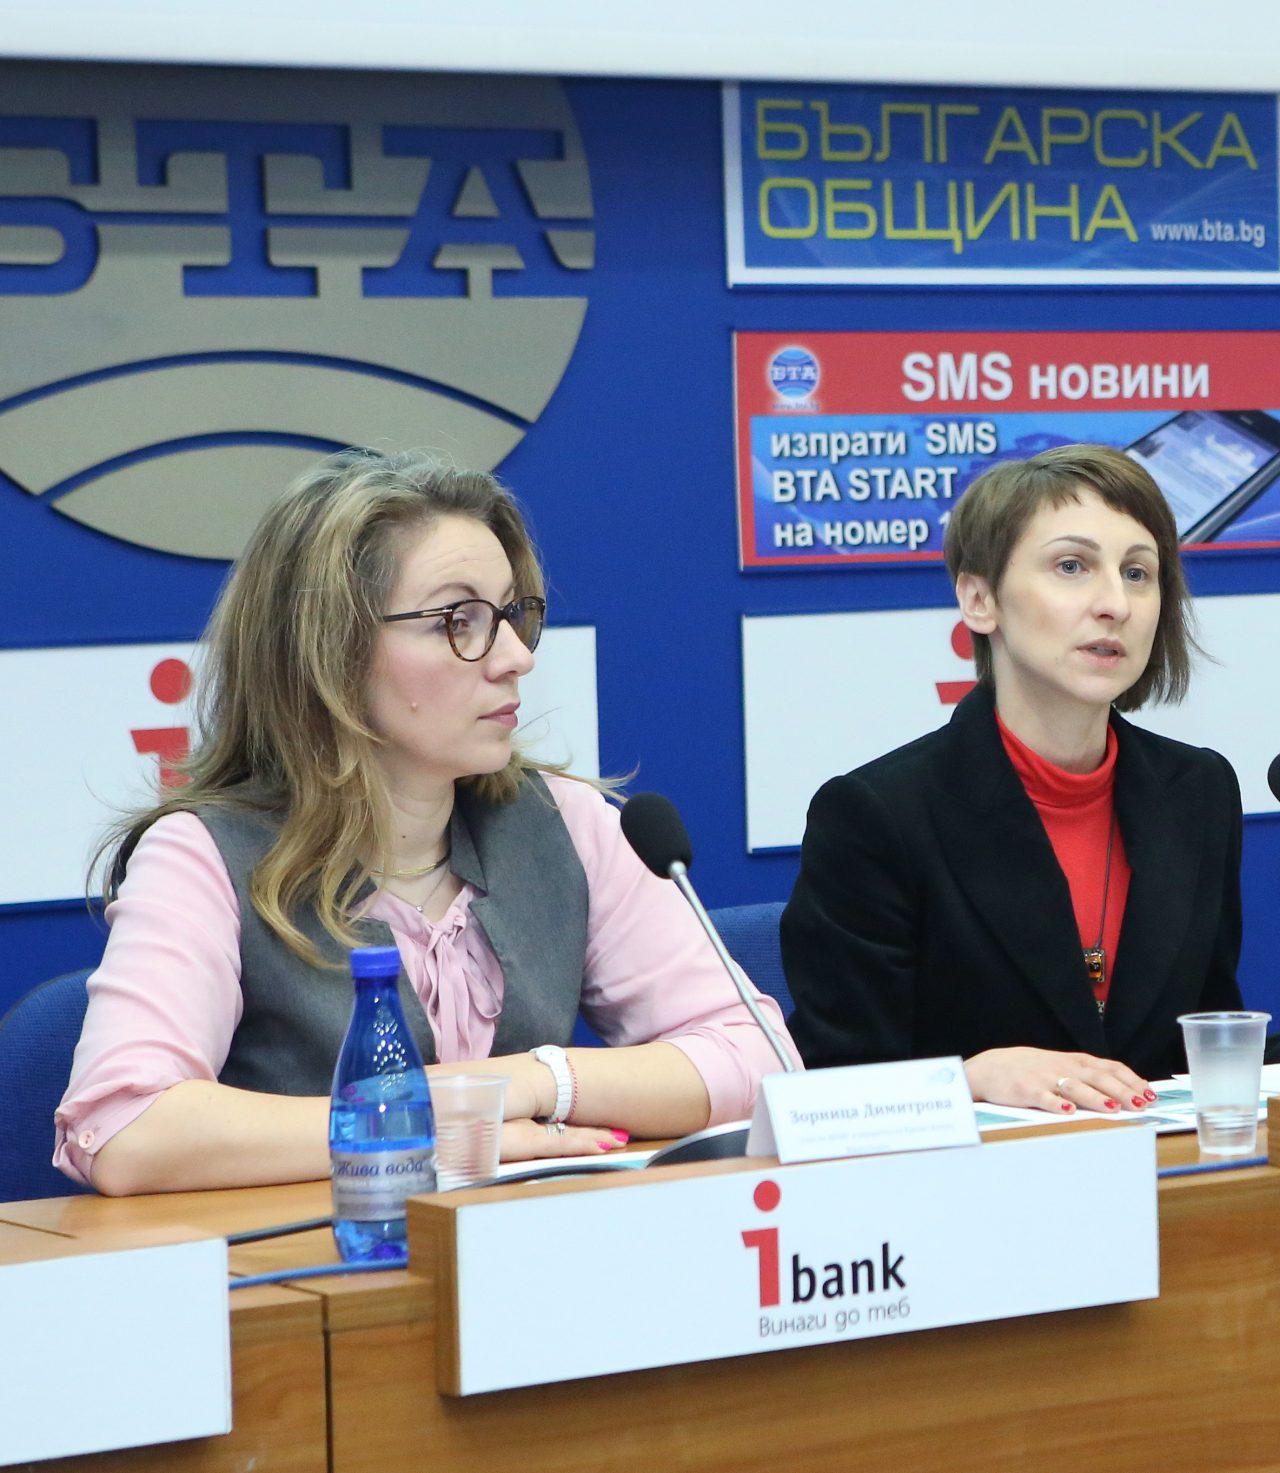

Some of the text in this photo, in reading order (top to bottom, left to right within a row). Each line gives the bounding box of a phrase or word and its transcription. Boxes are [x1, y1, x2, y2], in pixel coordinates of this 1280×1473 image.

[756, 99, 1258, 169] БЪЛГАРСКА
[759, 176, 1139, 254] ОБЩИНА
[1151, 220, 1266, 247] www.bta.bg
[902, 352, 1210, 401] SMS новини
[771, 422, 997, 464] изпрати SMS
[773, 467, 957, 502] BTA START
[774, 523, 814, 547] на
[824, 518, 929, 550] номер
[790, 1098, 952, 1126] Зорница Димитрова
[337, 1160, 379, 1177] Жива
[760, 1296, 911, 1337] Винаги до теб
